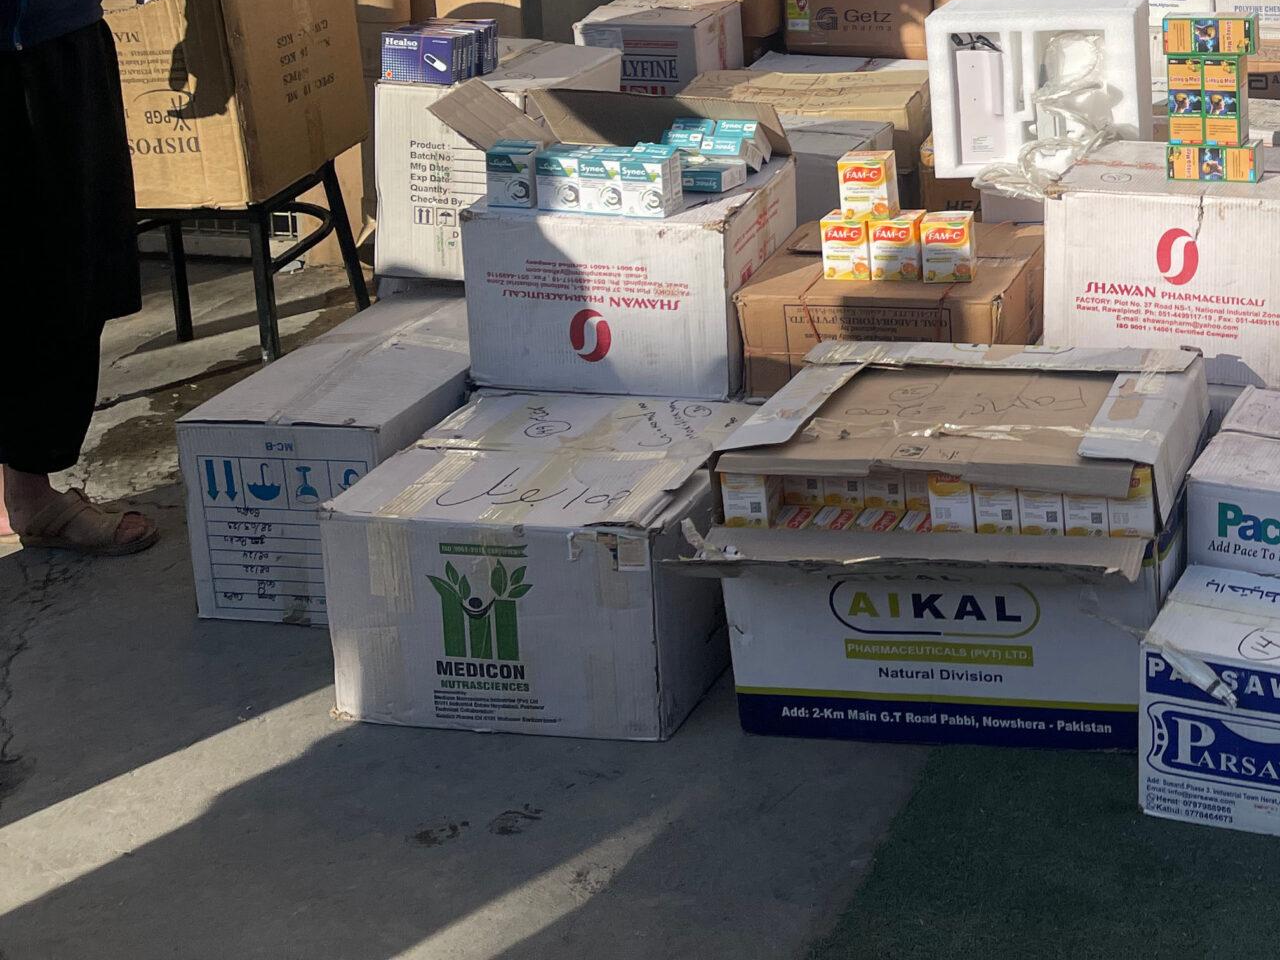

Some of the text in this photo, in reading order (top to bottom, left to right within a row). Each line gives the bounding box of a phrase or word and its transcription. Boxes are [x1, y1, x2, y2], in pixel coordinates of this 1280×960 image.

[1234, 5, 1264, 13] POLYFINE
[844, 10, 892, 23] Getz
[385, 38, 417, 46] Healso
[622, 57, 678, 79] LYFINE
[144, 110, 172, 124] PGB
[721, 121, 742, 130] Synec
[410, 141, 445, 150] Product
[410, 163, 427, 171] Mfg
[580, 163, 604, 174] Synec
[621, 166, 646, 176] Synec
[410, 174, 427, 182] Exp
[845, 169, 878, 179] FAM-C
[410, 185, 450, 195] Quantity:
[410, 195, 448, 205] Checked
[827, 230, 859, 238] FAM-C
[875, 230, 907, 239] FAM-C
[928, 231, 961, 240] FAM-C
[503, 289, 680, 310] SHAWAN PHARMACEUTICALS
[1085, 282, 1266, 307] SHAWAN PHARMACEUTICALS
[1076, 304, 1100, 312] Rawat,
[1114, 299, 1129, 307] Plot
[1154, 302, 1172, 310] Road
[1195, 306, 1225, 315] National
[1226, 309, 1260, 317] Industrial
[1175, 328, 1205, 336] Certified
[1206, 330, 1238, 339] Company
[265, 442, 294, 451] MC-B
[1207, 540, 1230, 554] Add
[1233, 543, 1257, 557] Pace
[1262, 548, 1275, 560] To
[848, 592, 1022, 622] AIKAL
[847, 643, 1031, 660] PHARMACEUTICALS (PVT) LTD.
[436, 660, 525, 680] MEDICON
[878, 667, 1003, 683] Natural Division
[441, 679, 530, 691] NUTRASCIENCES
[781, 706, 1112, 734] Add: 2-Km Main G.T Road Pabbi, Nowshera Pakistan
